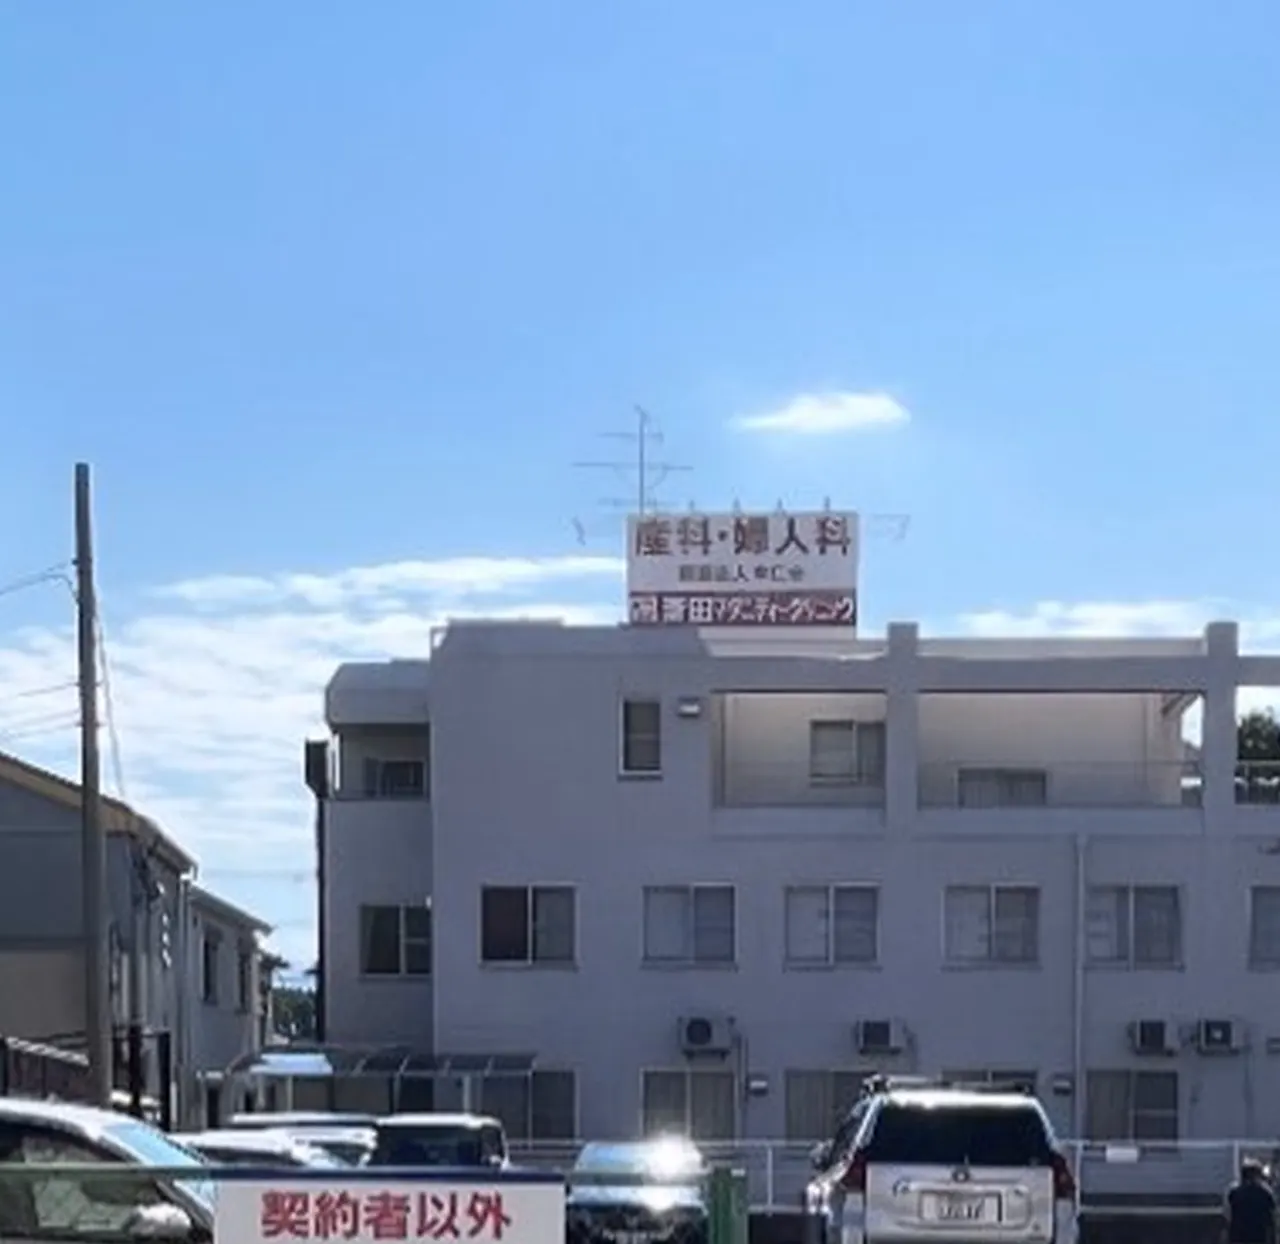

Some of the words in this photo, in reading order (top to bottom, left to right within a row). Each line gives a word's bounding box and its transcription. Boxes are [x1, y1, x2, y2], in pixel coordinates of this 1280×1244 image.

[635, 516, 852, 557] 産科・婦人科
[260, 1190, 512, 1240] 契約者以外
